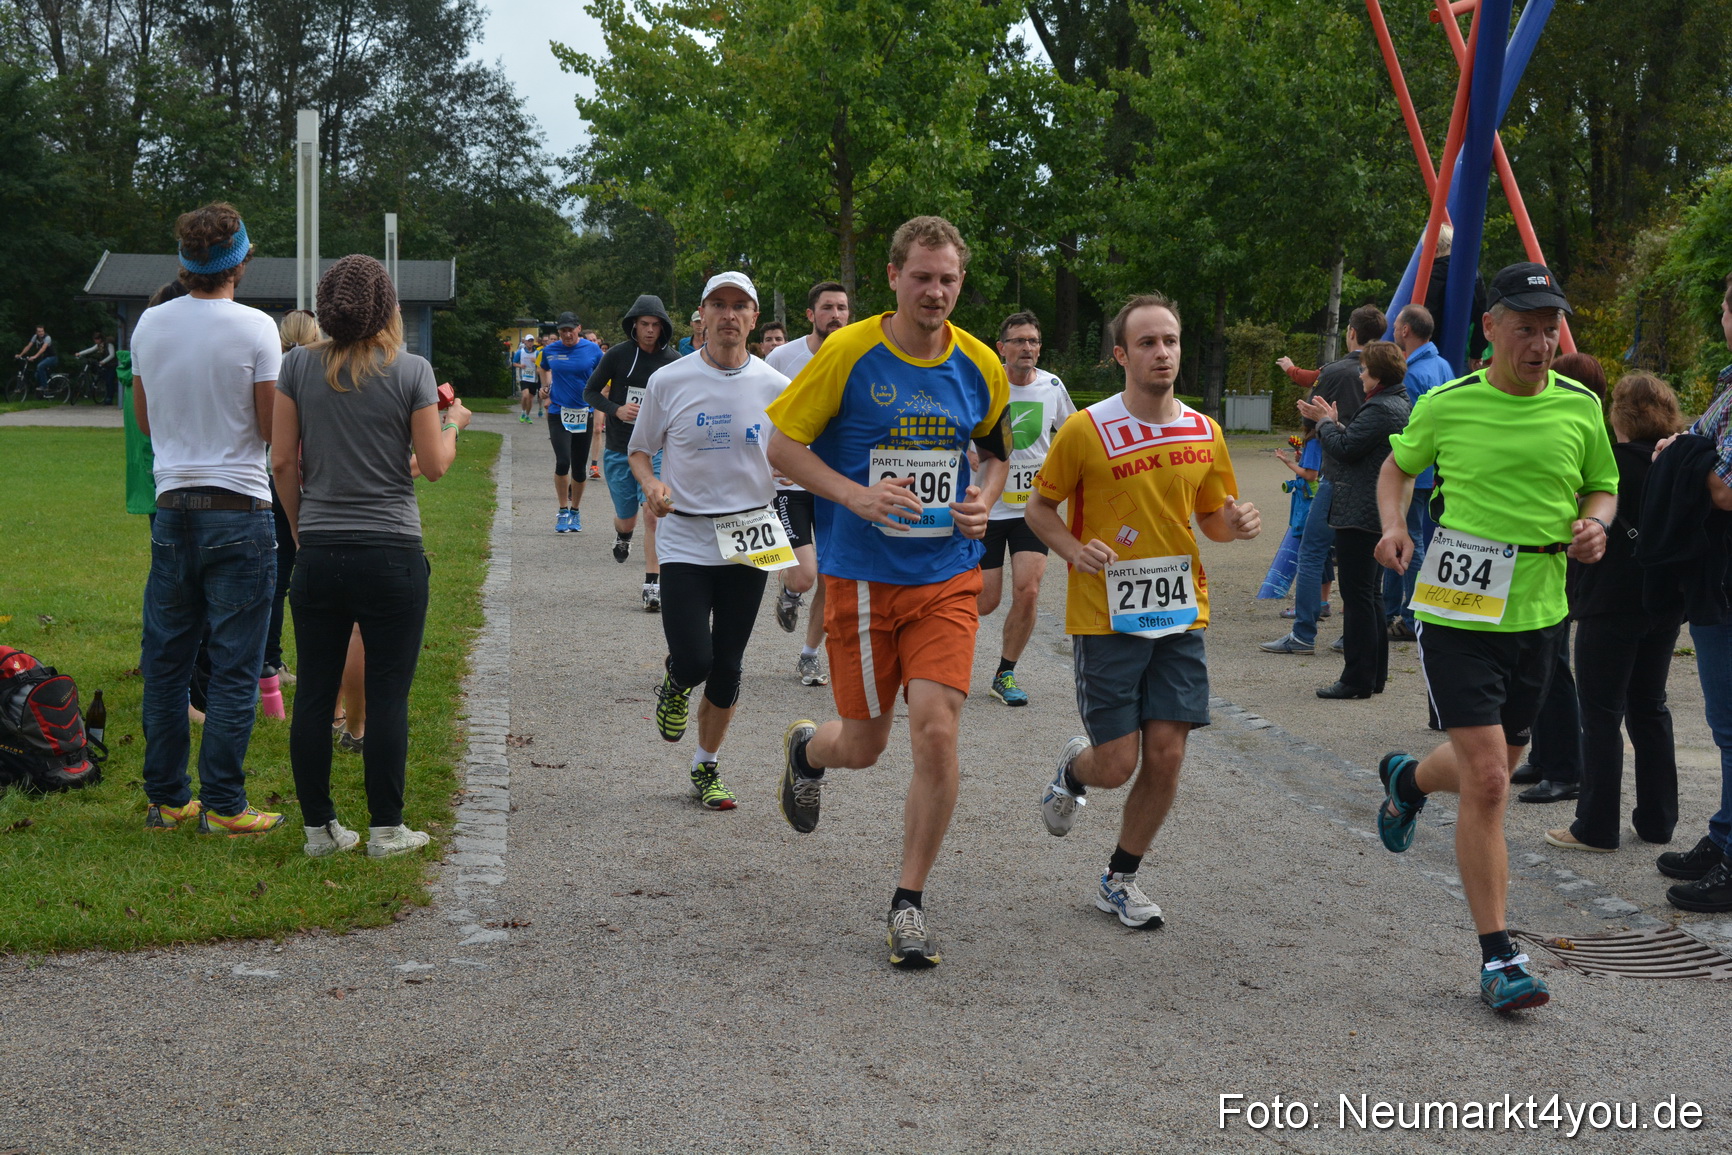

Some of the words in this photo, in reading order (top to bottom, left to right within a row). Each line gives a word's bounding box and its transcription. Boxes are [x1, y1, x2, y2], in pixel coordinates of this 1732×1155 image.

[563, 412, 586, 423] 2212
[696, 412, 709, 427] 6.
[872, 458, 904, 467] PARTL
[906, 459, 946, 468] Neumarkt
[1111, 454, 1163, 480] MAX
[1169, 446, 1214, 466] BÖGL
[880, 471, 951, 503] 496
[1013, 470, 1039, 490] 13
[716, 520, 740, 530] PARTL
[742, 514, 769, 526] Neumarkt
[731, 523, 776, 552] 320
[1433, 536, 1455, 546] PARTL
[1456, 540, 1500, 555] Neumarkt
[1107, 568, 1138, 577] PARTL
[1140, 564, 1178, 575] Neumarkt
[1437, 551, 1493, 590] 634
[1117, 576, 1188, 610] 2794
[1425, 585, 1484, 609] HOLGER
[1138, 616, 1174, 628] Stefan
